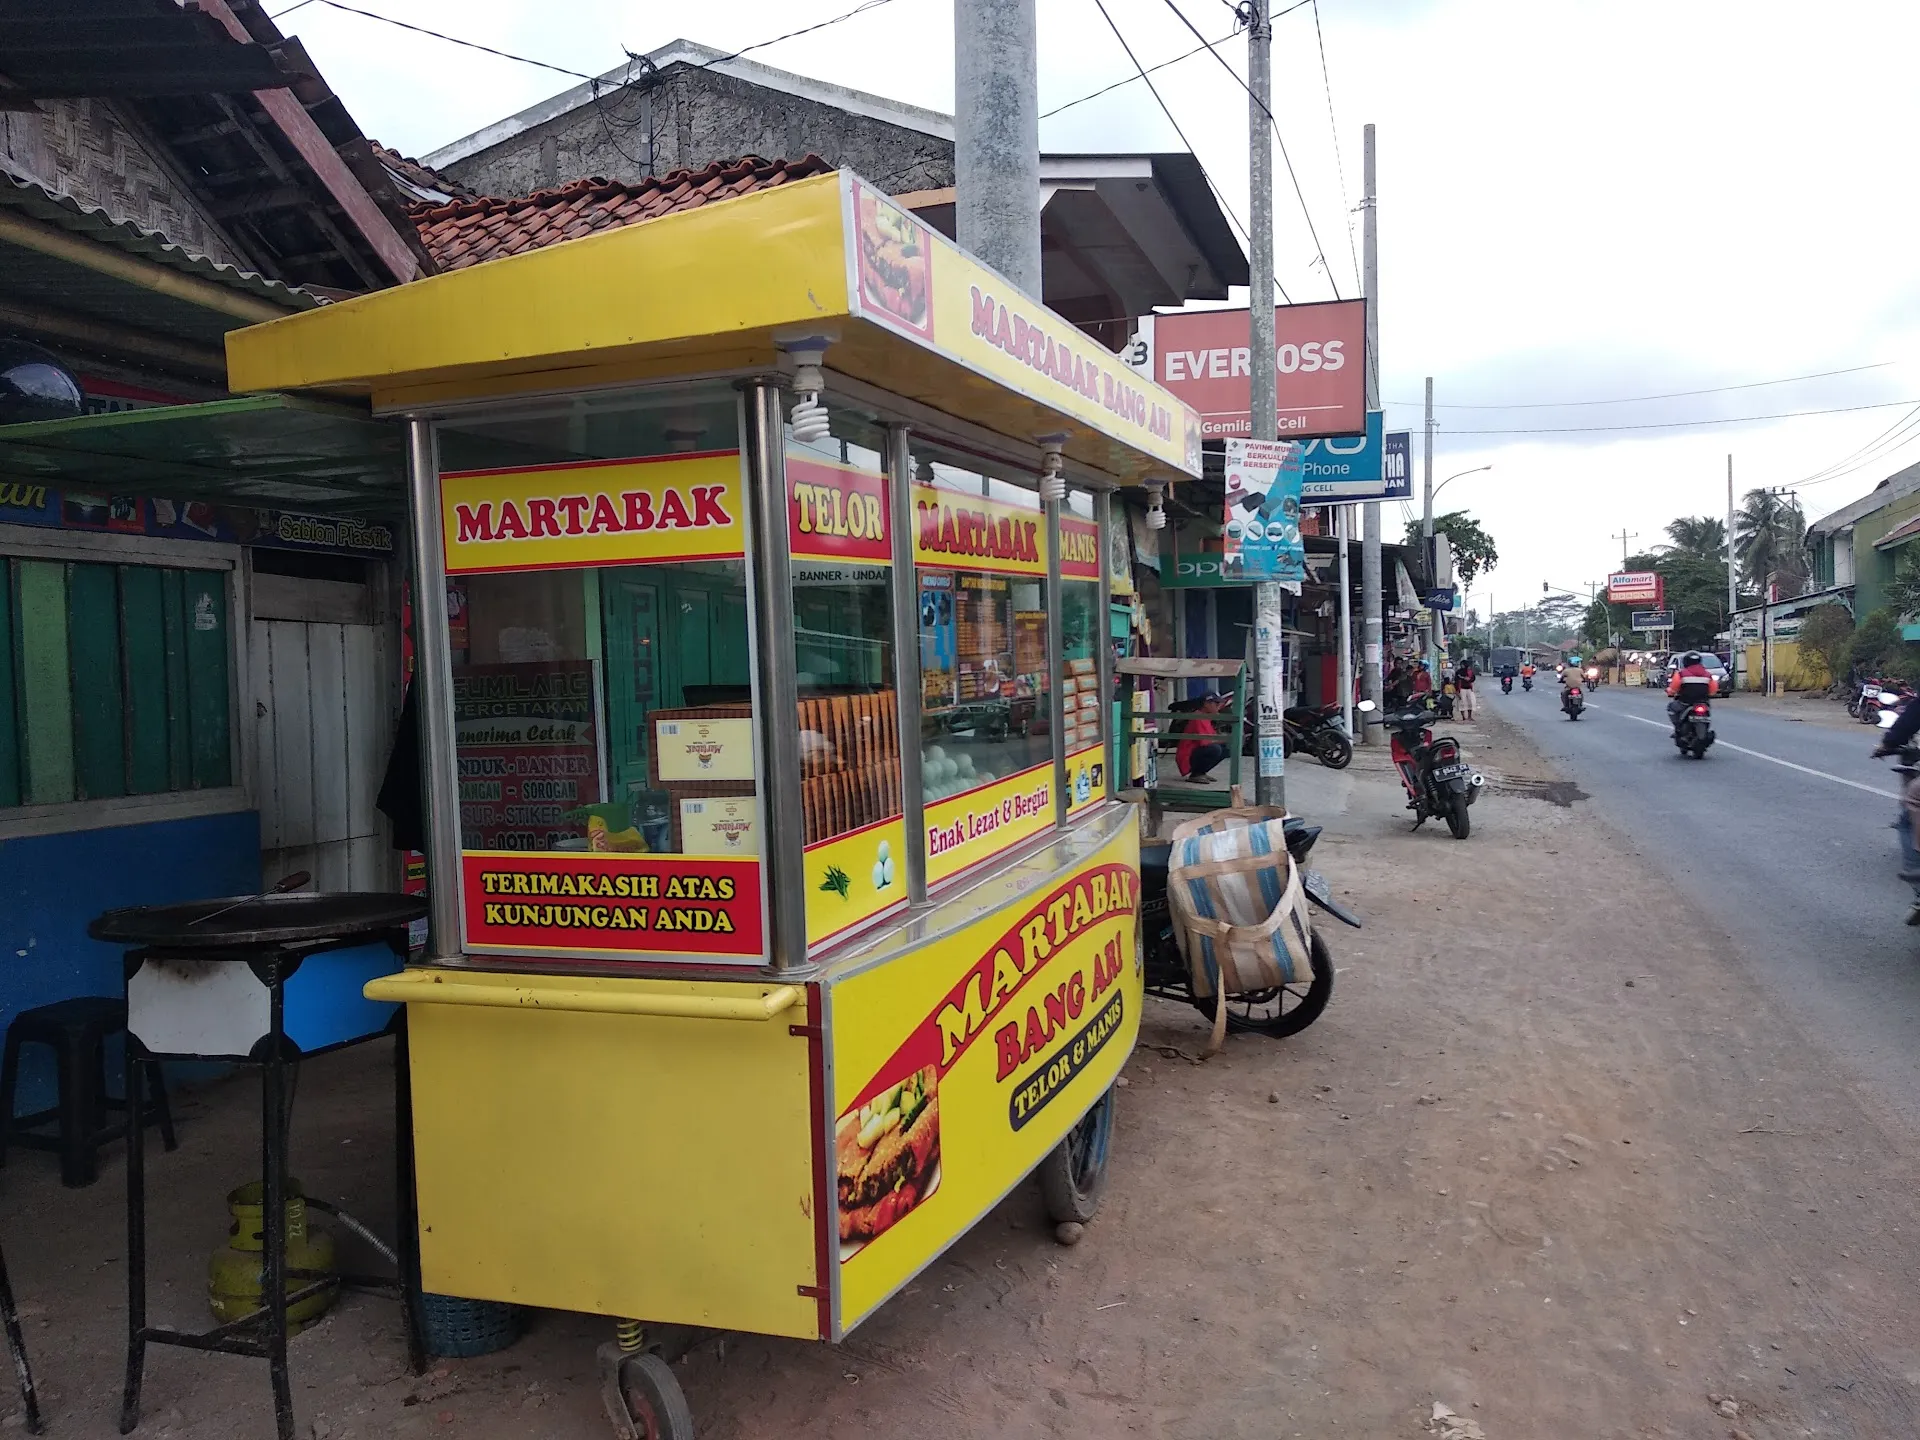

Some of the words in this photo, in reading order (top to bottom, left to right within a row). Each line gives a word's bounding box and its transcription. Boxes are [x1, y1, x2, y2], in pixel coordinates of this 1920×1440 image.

[971, 286, 1100, 404] MARTABAK
[1104, 371, 1146, 428] BANG
[1165, 340, 1345, 382] EVEROSS
[1277, 416, 1306, 430] Cell
[1245, 443, 1273, 451] PAVING
[1302, 462, 1350, 477] Phone
[456, 486, 732, 542] MARTABAK
[793, 480, 884, 542] TELOR
[279, 516, 336, 546] Sablon
[337, 522, 392, 550] Plastik
[917, 500, 1039, 563] MARTABAK
[1059, 527, 1097, 564] MANIS
[799, 571, 842, 581] BANNER
[852, 570, 885, 581] UNDA
[1613, 575, 1653, 584] Alfamart
[526, 724, 577, 744] Cetak
[516, 755, 590, 776] BANNER
[1262, 746, 1282, 758] WC
[523, 780, 577, 799] SOROGAN
[506, 806, 563, 824] STIKER
[928, 824, 965, 857] Enak
[968, 808, 1000, 847] Lezat
[1002, 799, 1012, 824] &
[1014, 784, 1050, 824] Bergizi
[481, 872, 660, 899] TERIMAKASIH
[664, 876, 735, 900] ATAS
[484, 902, 648, 929] KUNJUNGAN
[654, 907, 734, 933] ANDA
[935, 868, 1134, 1067] MARTABAK
[994, 969, 1086, 1083] BANG
[1091, 930, 1123, 1003] ARI
[1012, 1053, 1072, 1120] TELOR
[1072, 1041, 1086, 1067] &
[1086, 997, 1122, 1056] MANIS
